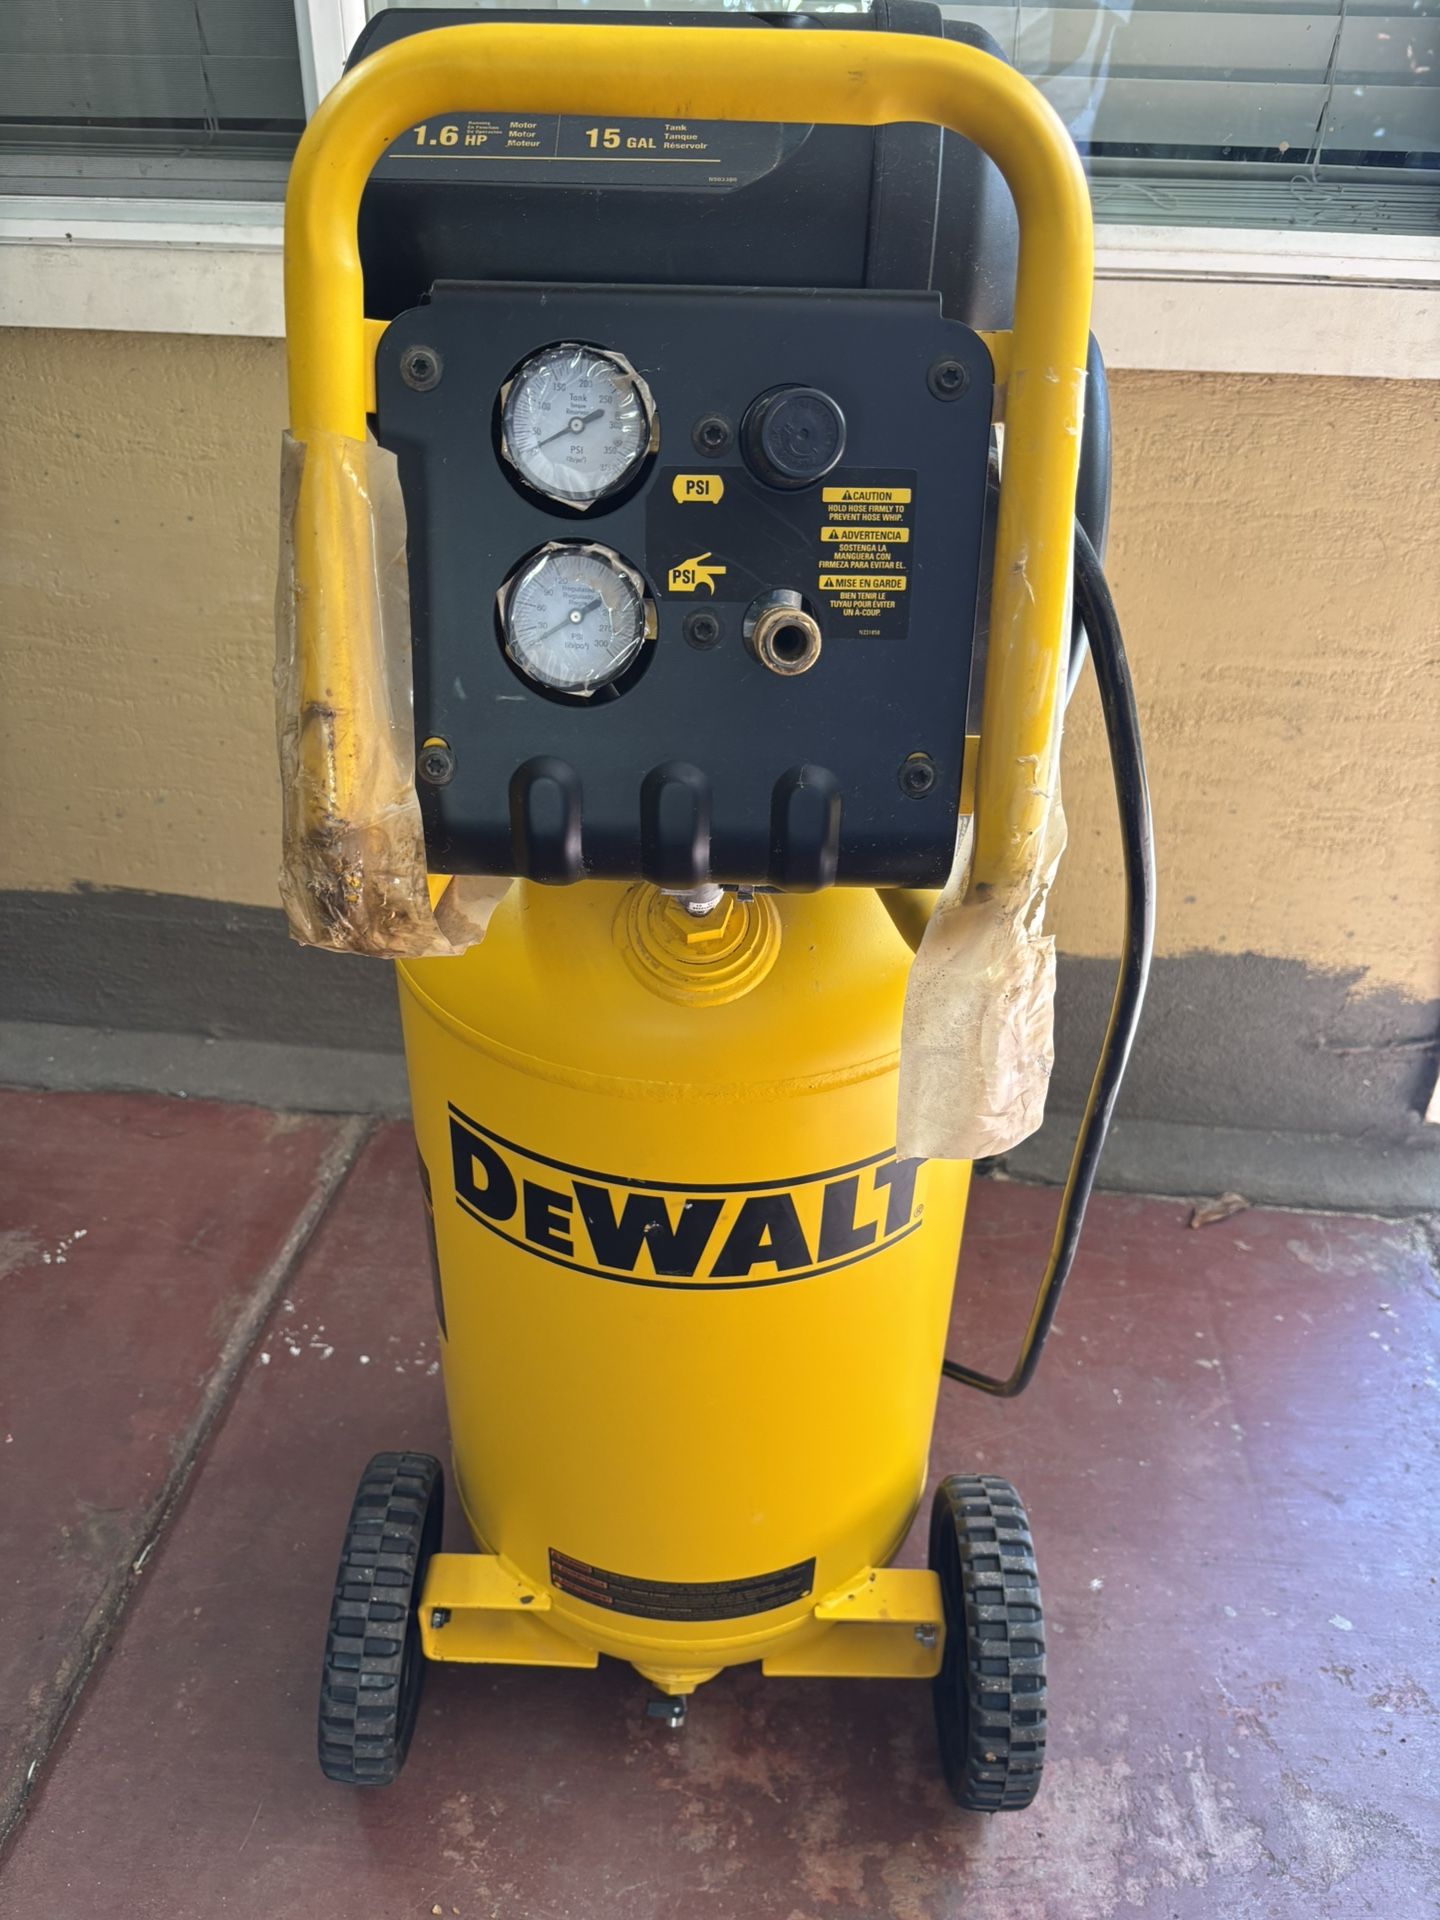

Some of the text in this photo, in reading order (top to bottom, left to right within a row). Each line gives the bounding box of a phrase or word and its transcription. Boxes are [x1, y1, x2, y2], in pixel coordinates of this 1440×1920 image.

[509, 121, 537, 129] Motor
[414, 125, 488, 146] 1.6 HP
[508, 130, 536, 138] Motor
[585, 128, 657, 149] 15 GAL
[664, 133, 698, 141] Tanque
[507, 139, 541, 148] Moteur
[686, 480, 709, 495] PSI
[853, 491, 892, 501] CAUTION
[828, 504, 904, 513] HOLD HOSE FIRMLY TO
[829, 512, 904, 522] PREVENT HOSE WHIP.
[841, 531, 902, 541] ADVERTENCIA
[839, 544, 887, 552] SOSTENGA LA
[834, 552, 891, 561] MANGUERA CON
[819, 560, 849, 569] FIRMEZA
[850, 561, 868, 569] PARA
[870, 561, 894, 569] EVITAR
[672, 569, 695, 584] PSI
[835, 578, 902, 589] MISE EN GARDE
[840, 592, 886, 600] BIEN TENIR LE
[830, 600, 852, 608] TUYAU
[843, 608, 853, 616] UN
